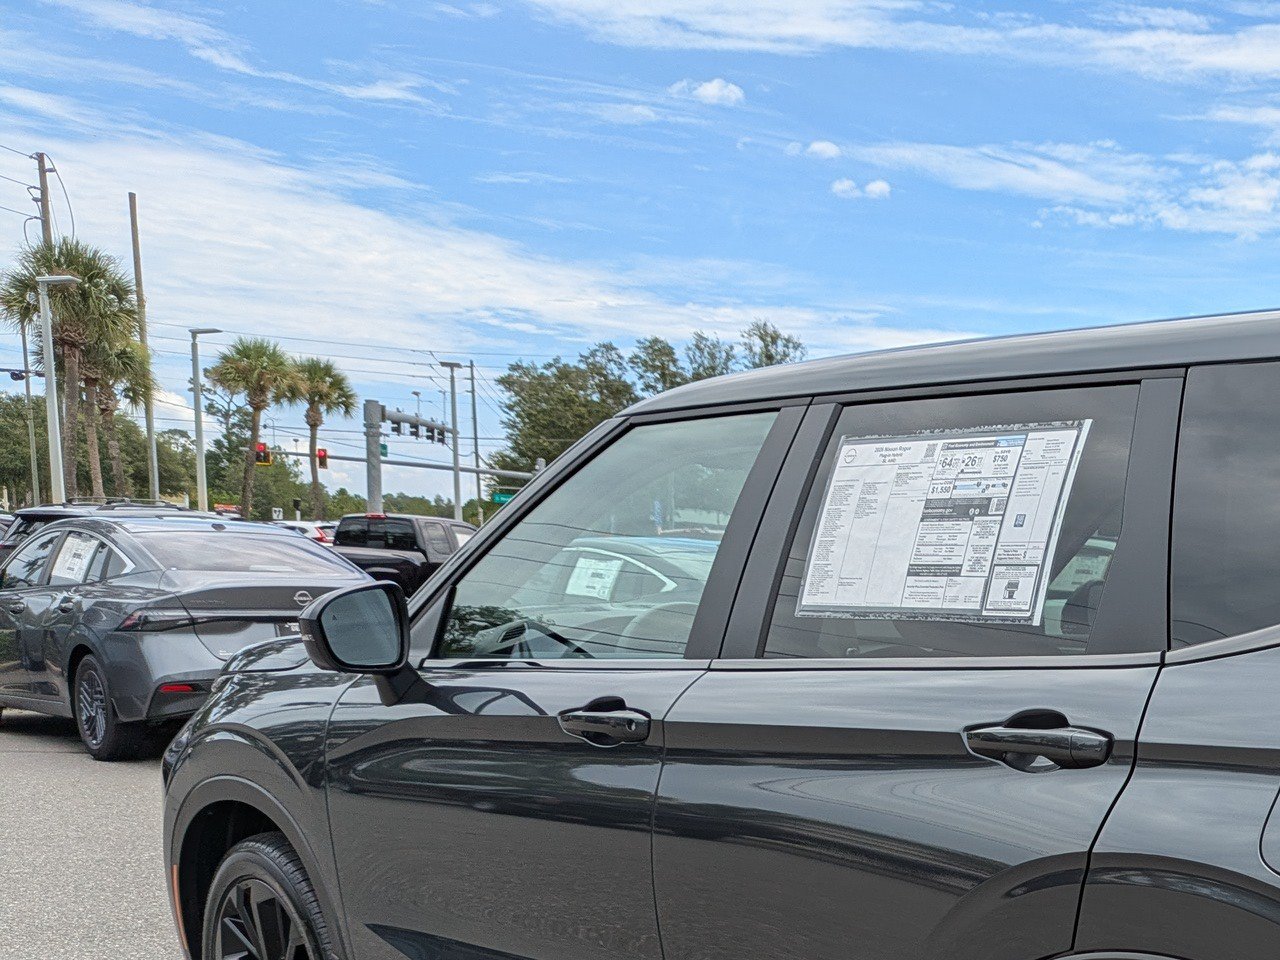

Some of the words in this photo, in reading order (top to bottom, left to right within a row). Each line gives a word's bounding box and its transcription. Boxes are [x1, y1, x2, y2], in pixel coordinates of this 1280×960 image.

[941, 458, 953, 468] 64
[964, 456, 977, 467] 26
[992, 455, 1009, 463] $750
